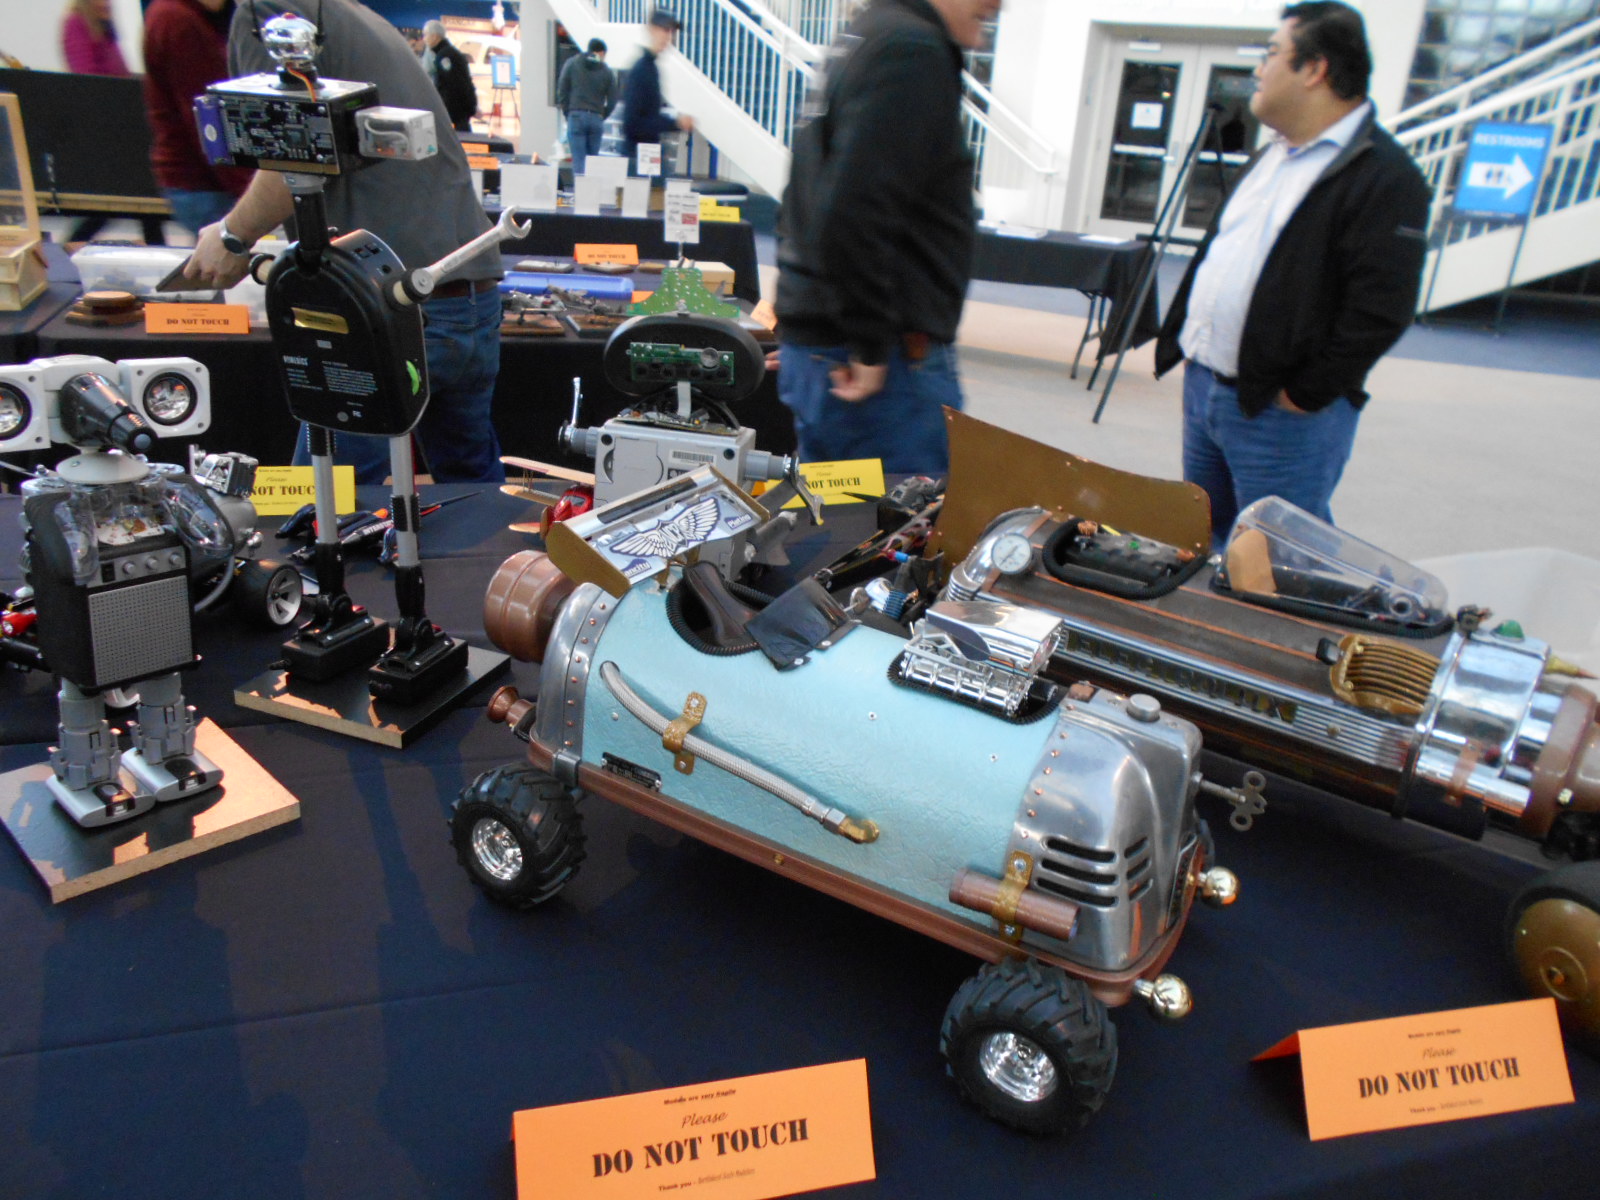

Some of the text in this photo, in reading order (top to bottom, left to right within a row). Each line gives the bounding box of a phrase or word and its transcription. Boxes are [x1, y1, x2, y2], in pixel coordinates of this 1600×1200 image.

[1475, 133, 1546, 149] RESTROOMS
[827, 477, 861, 487] TOUCH
[280, 485, 316, 496] TOUC
[1423, 1047, 1456, 1060] Please
[1358, 1057, 1520, 1099] DO NOT TOUCH
[682, 1111, 728, 1129] Please
[592, 1117, 810, 1178] DO NOT TOUCH
